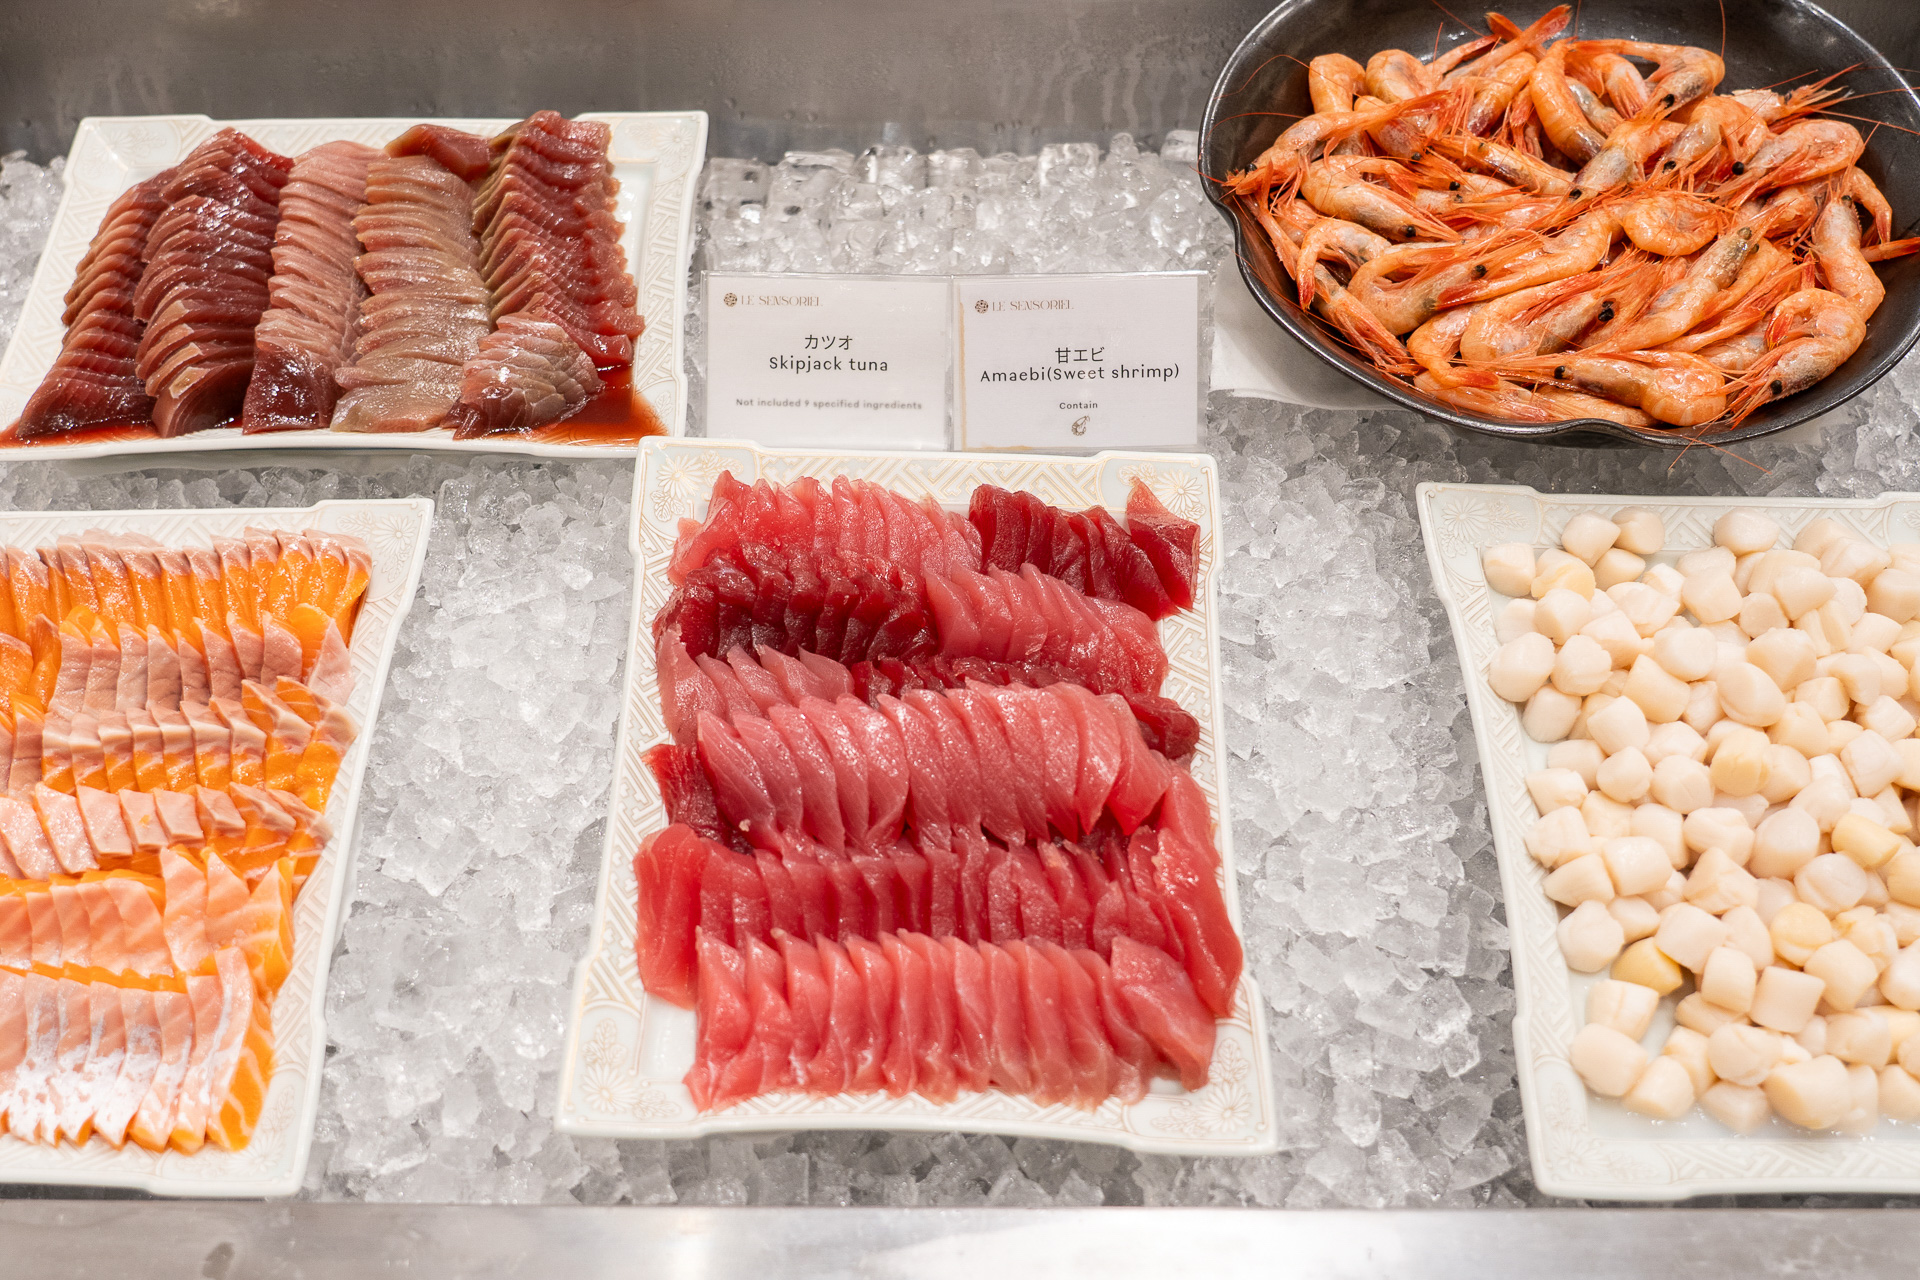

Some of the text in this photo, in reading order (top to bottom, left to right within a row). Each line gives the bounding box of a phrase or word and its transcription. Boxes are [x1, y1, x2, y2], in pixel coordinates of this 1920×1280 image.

[741, 295, 823, 307] LE SENSORIEL
[992, 299, 1074, 312] LE SENSORIEL
[804, 334, 853, 350] カツオ
[1055, 346, 1104, 364] 甘エビ
[769, 355, 888, 374] Skipjack tuna
[980, 363, 1179, 382] Amaebi(Sweet shrimp)
[736, 398, 922, 410] Not included 9 specified ingredients
[1059, 400, 1098, 410] Contain
